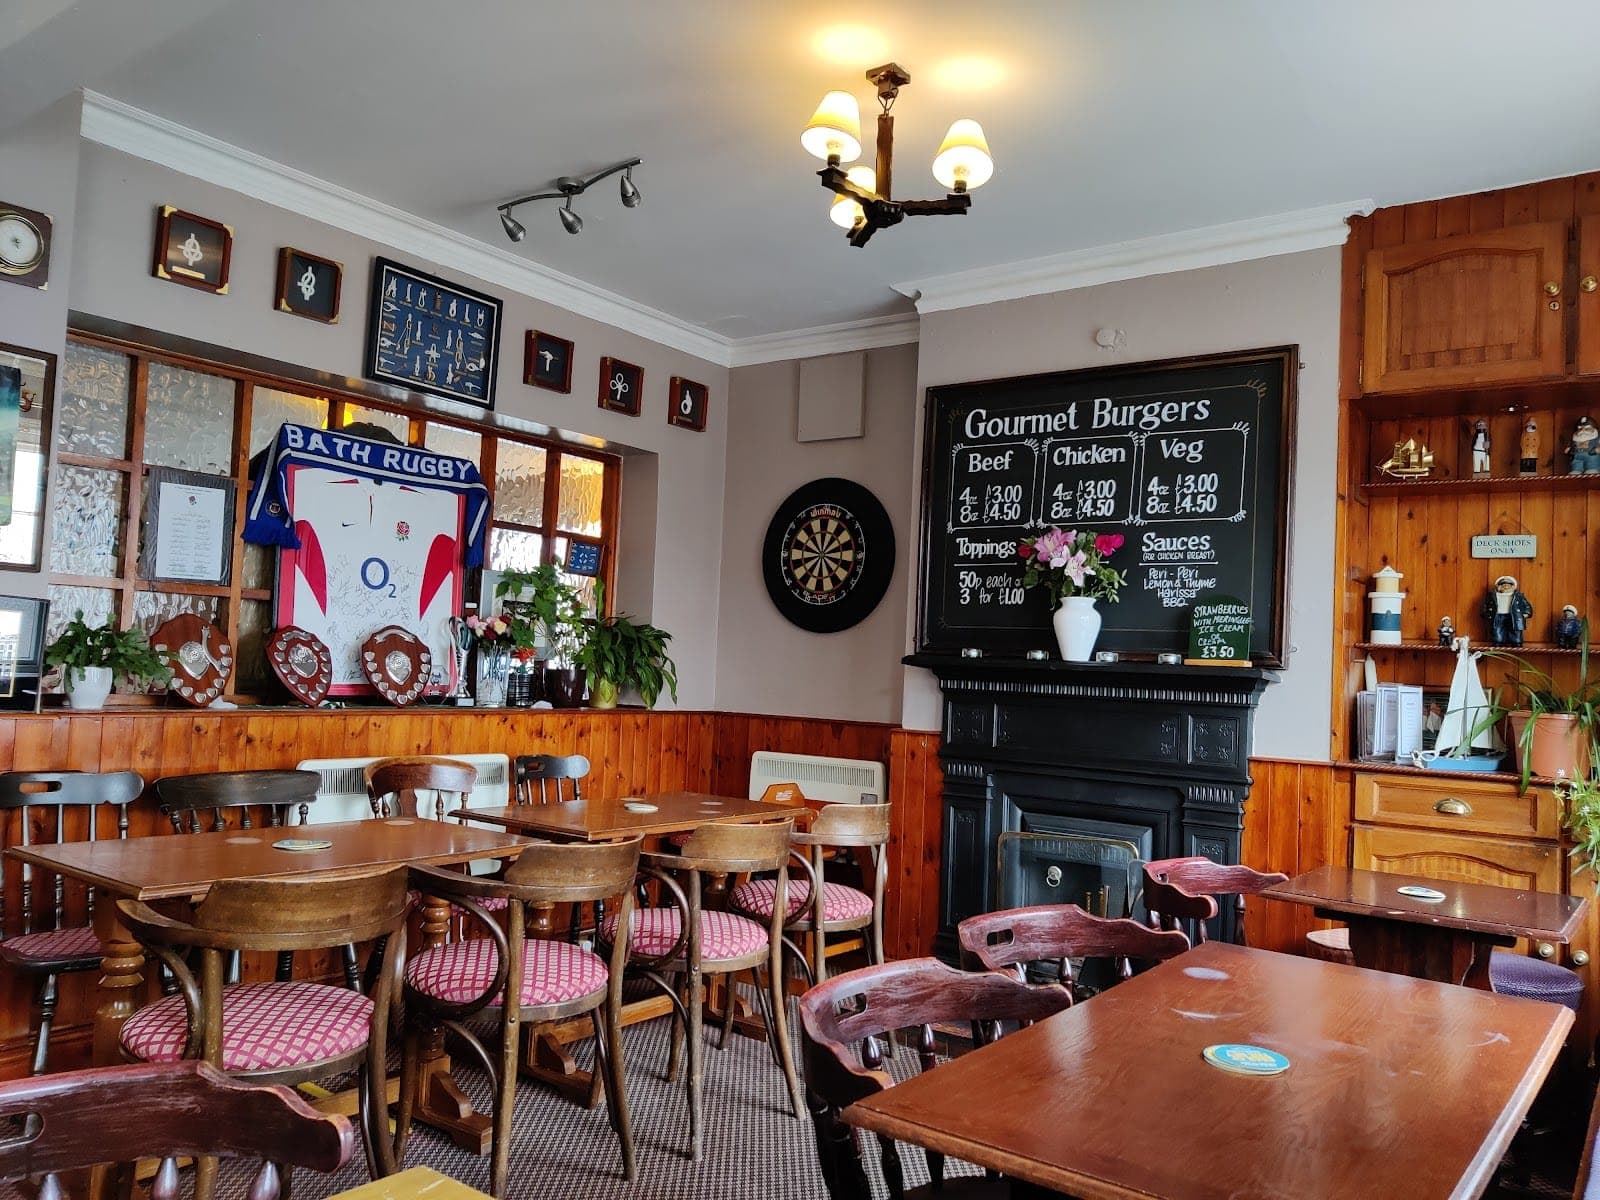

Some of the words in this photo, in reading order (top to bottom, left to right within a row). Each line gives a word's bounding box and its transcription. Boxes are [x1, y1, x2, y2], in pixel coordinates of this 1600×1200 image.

[964, 402, 1079, 438] Gourmet
[1092, 398, 1211, 430] Burgers
[284, 424, 371, 464] BATH
[383, 448, 473, 480] RUGBY
[968, 450, 1014, 472] Beef
[1053, 444, 1126, 466] Chicken
[1160, 438, 1204, 463] Veg
[984, 483, 1022, 504] £3.00
[1052, 483, 1073, 501] 4oz
[1076, 480, 1117, 501] £3.00
[1148, 476, 1170, 495] 4oz
[1175, 473, 1218, 495] £3.00
[1051, 501, 1073, 519] 8oz
[1076, 499, 1115, 520] £4.50
[1146, 496, 1171, 515] 8oz
[1174, 493, 1218, 515] £4.50
[956, 537, 1017, 559] Toppings
[1141, 532, 1211, 552] Sauces
[959, 571, 983, 590] 50p
[985, 572, 1012, 589] each
[959, 588, 970, 605] 3
[979, 586, 994, 605] for
[998, 587, 1025, 605] £1.00
[1157, 588, 1196, 599] Harissa
[1163, 597, 1189, 608] BBQ
[1193, 604, 1249, 618] STRAWBERRIES
[1216, 624, 1244, 633] CREAM
